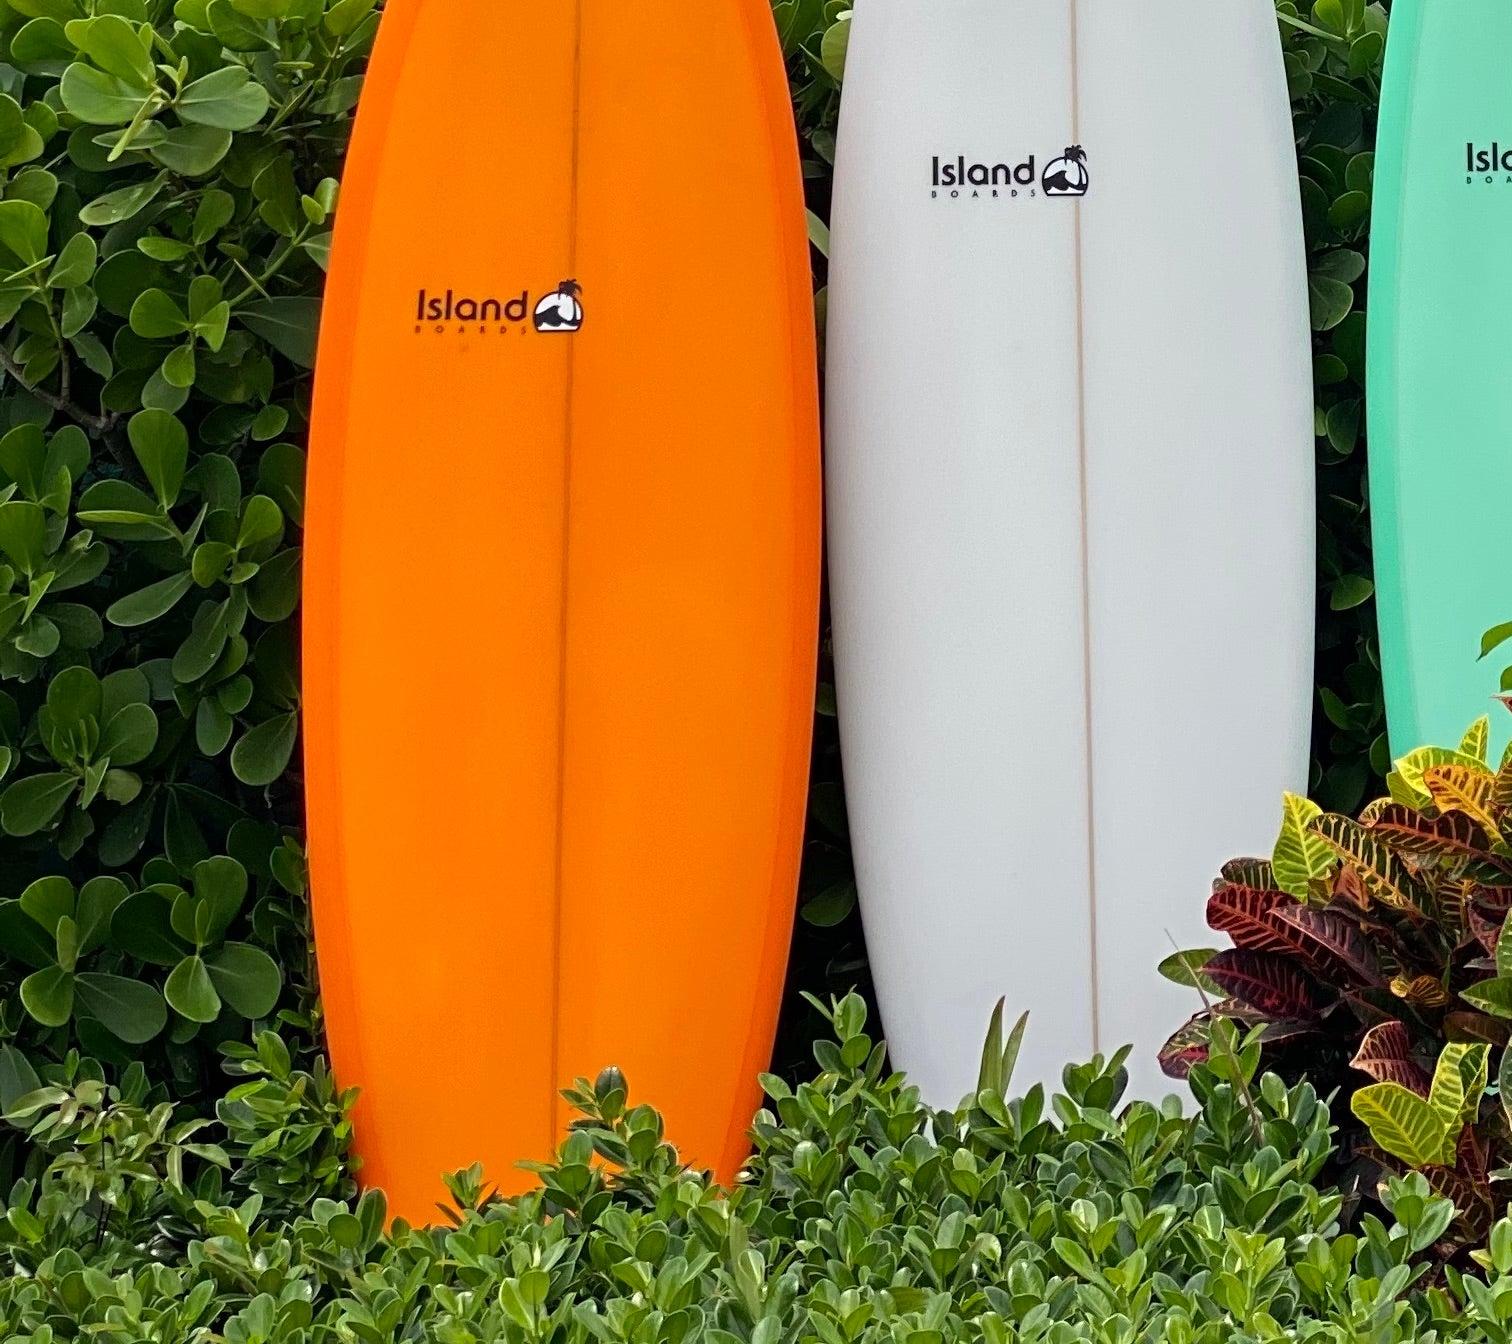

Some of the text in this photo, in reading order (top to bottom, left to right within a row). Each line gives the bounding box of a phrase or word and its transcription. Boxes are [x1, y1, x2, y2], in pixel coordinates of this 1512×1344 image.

[931, 154, 1035, 186] Island
[931, 189, 1036, 198] BOARDS
[417, 289, 529, 322] Island
[415, 325, 527, 335] BOARDS
